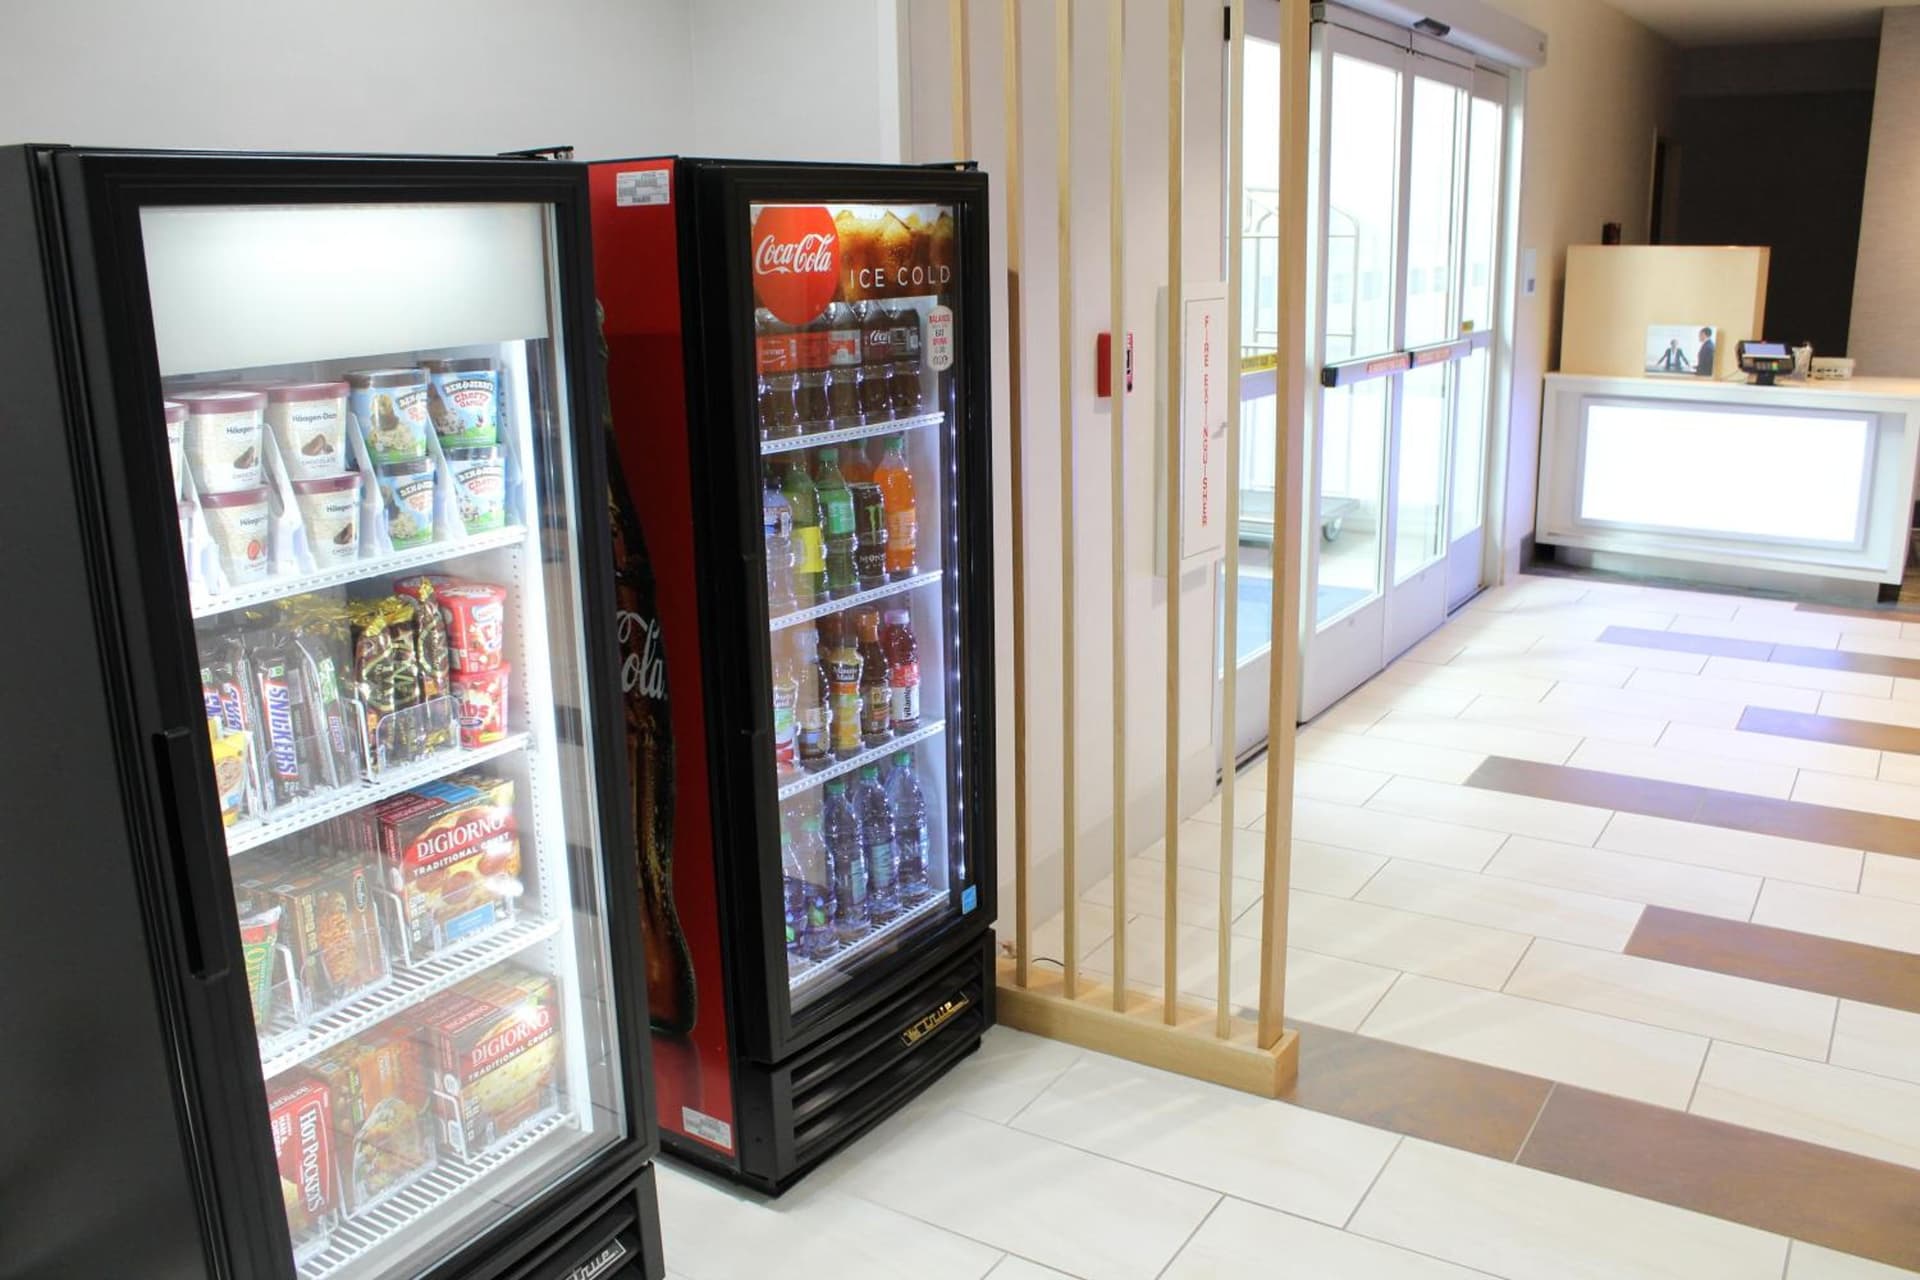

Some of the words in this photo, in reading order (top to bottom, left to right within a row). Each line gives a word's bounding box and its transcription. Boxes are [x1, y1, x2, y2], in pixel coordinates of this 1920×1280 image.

[755, 233, 834, 275] Coca-Cola
[850, 267, 886, 289] ICE
[896, 264, 951, 287] COLD
[269, 686, 297, 775] SNICKERS
[416, 815, 506, 859] DIGIORNO
[412, 846, 479, 878] TRADITIONAL
[468, 1045, 525, 1082] TRADITIONAL
[302, 1142, 325, 1213] POCKETS
